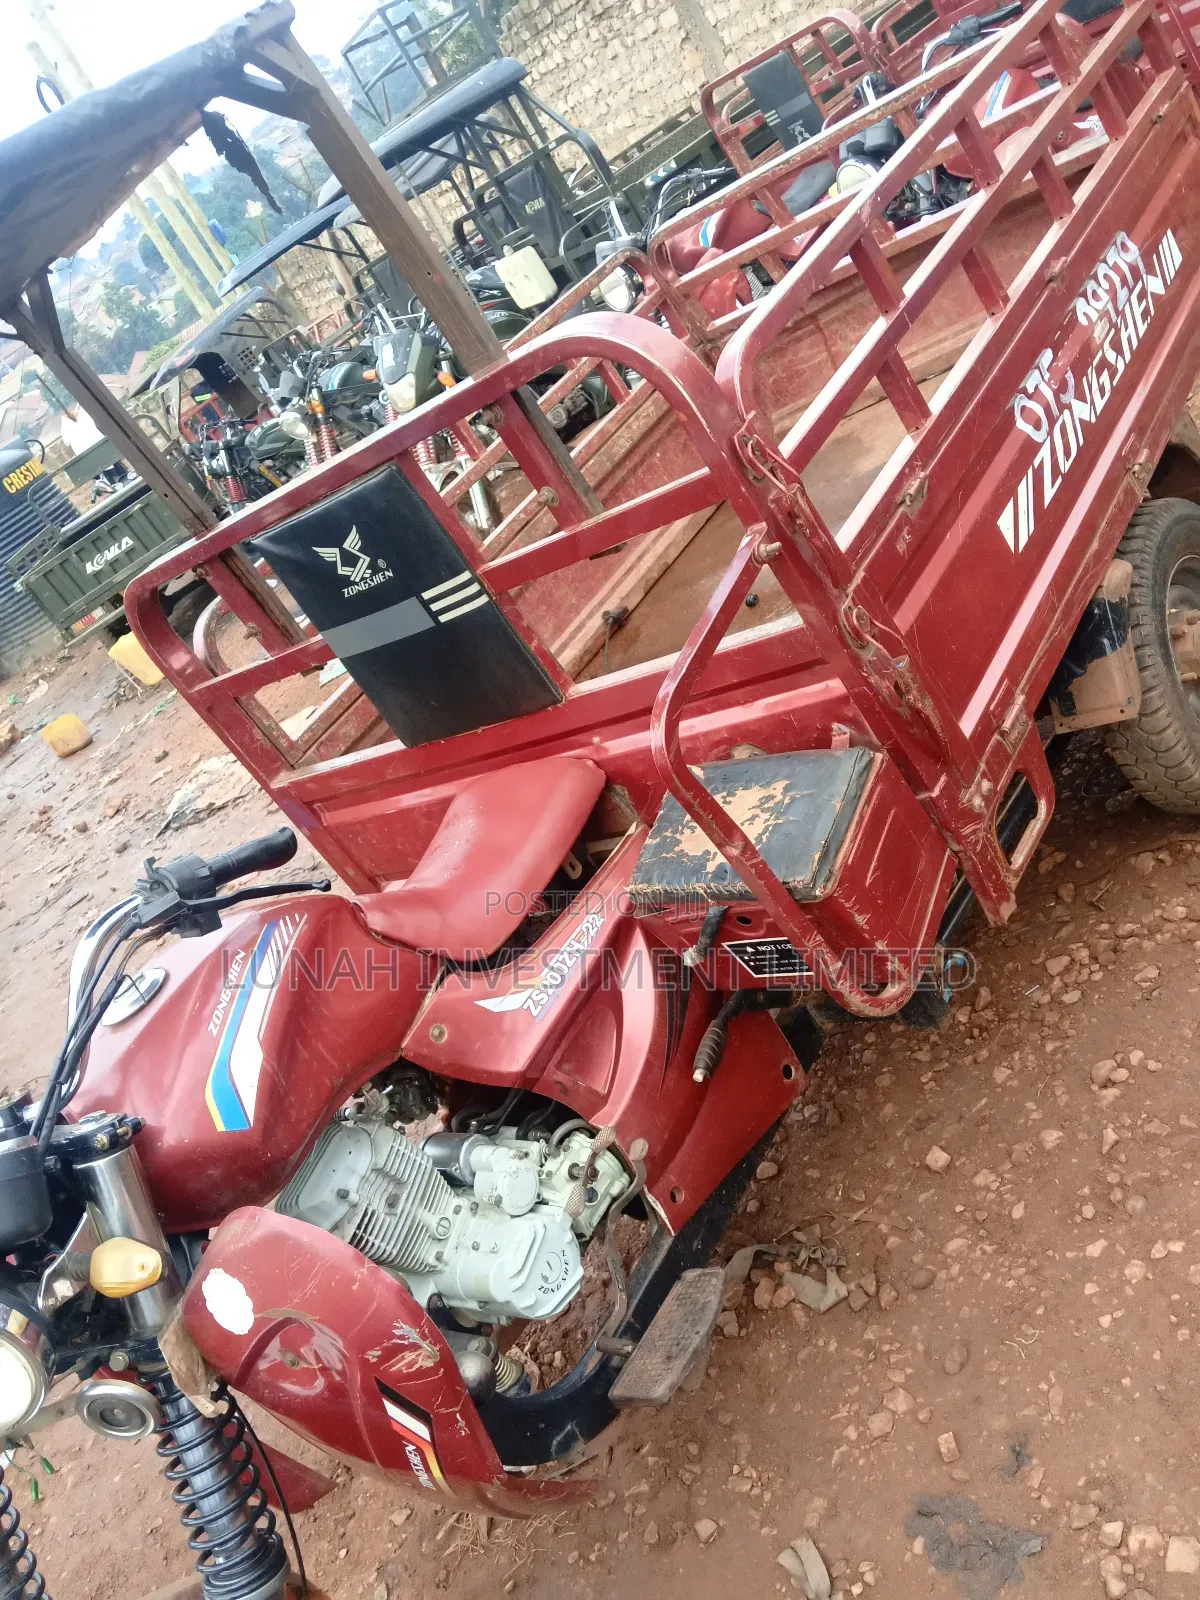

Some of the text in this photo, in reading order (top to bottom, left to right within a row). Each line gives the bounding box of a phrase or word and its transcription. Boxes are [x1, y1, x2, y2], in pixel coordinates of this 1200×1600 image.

[1033, 253, 1166, 509] ZONGSHEN
[342, 569, 394, 598] ZONGSHEN
[207, 947, 247, 1038] ZONGSHEN
[538, 1249, 569, 1295] ZONGSHEN
